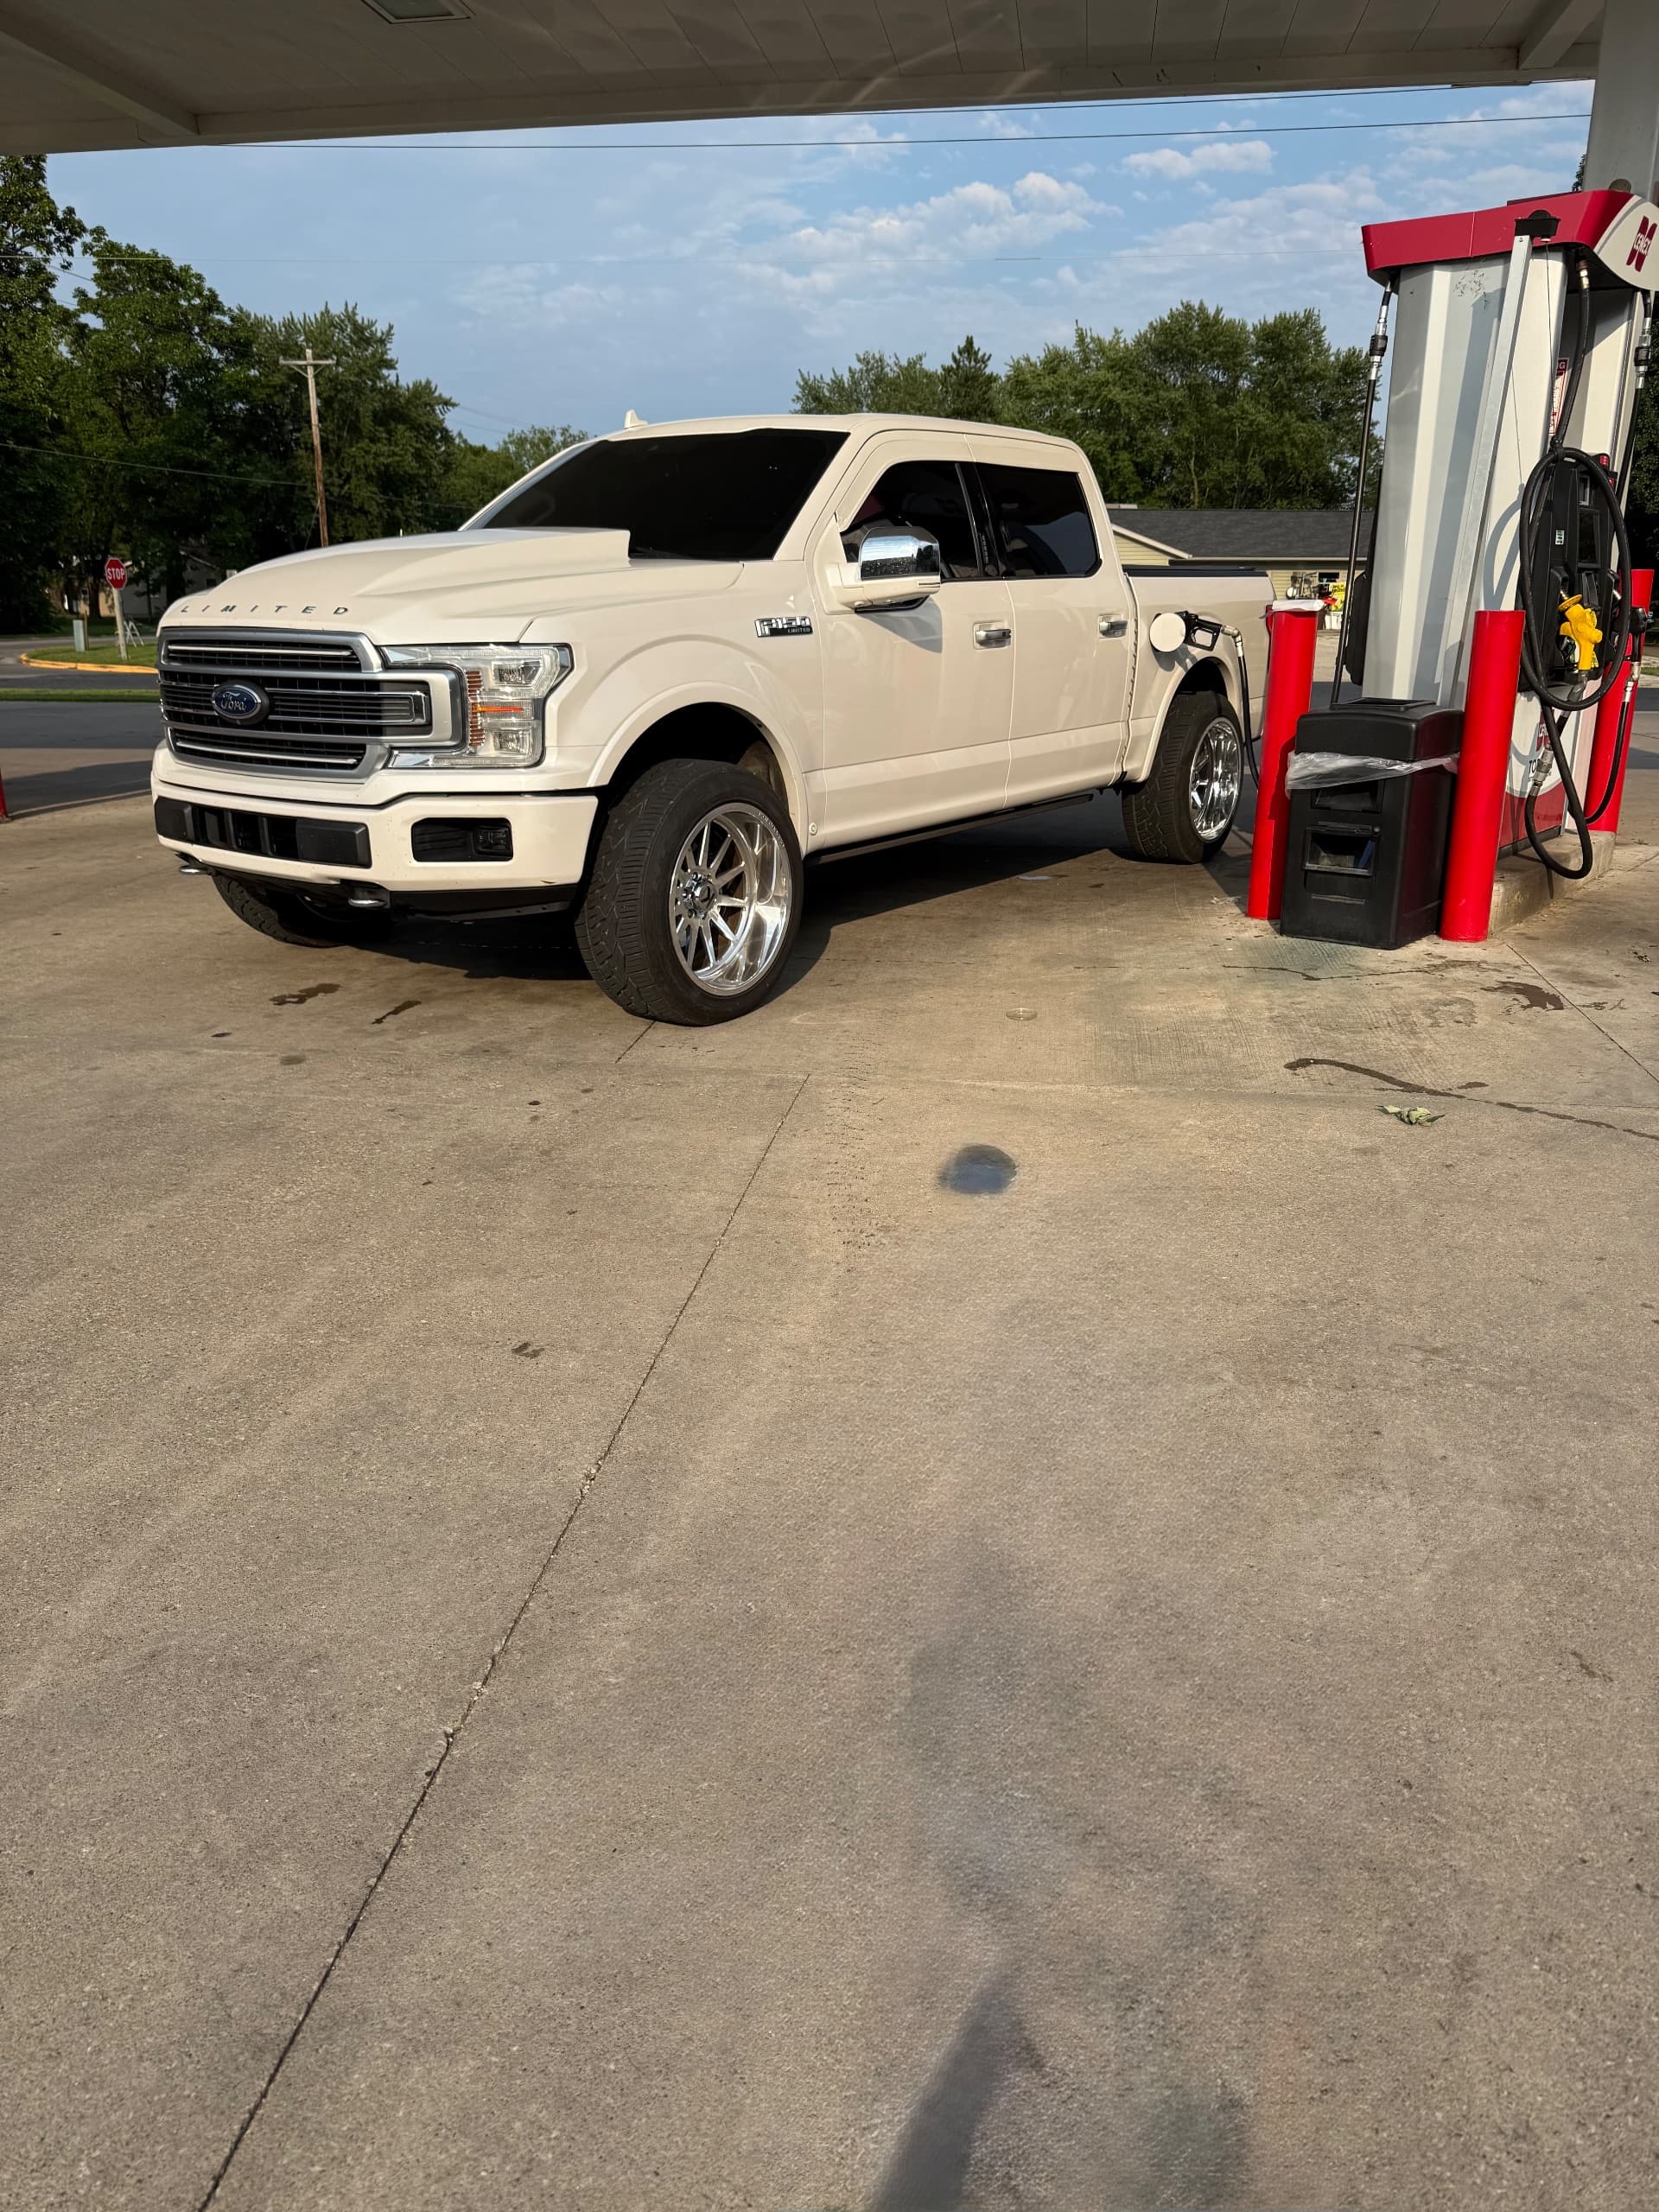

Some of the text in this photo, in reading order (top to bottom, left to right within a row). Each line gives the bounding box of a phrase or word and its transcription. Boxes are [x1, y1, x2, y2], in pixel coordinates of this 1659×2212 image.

[1633, 232, 1651, 256] CENEX
[107, 567, 125, 581] STOP
[180, 605, 349, 615] LIMITED
[220, 691, 247, 711] Ford
